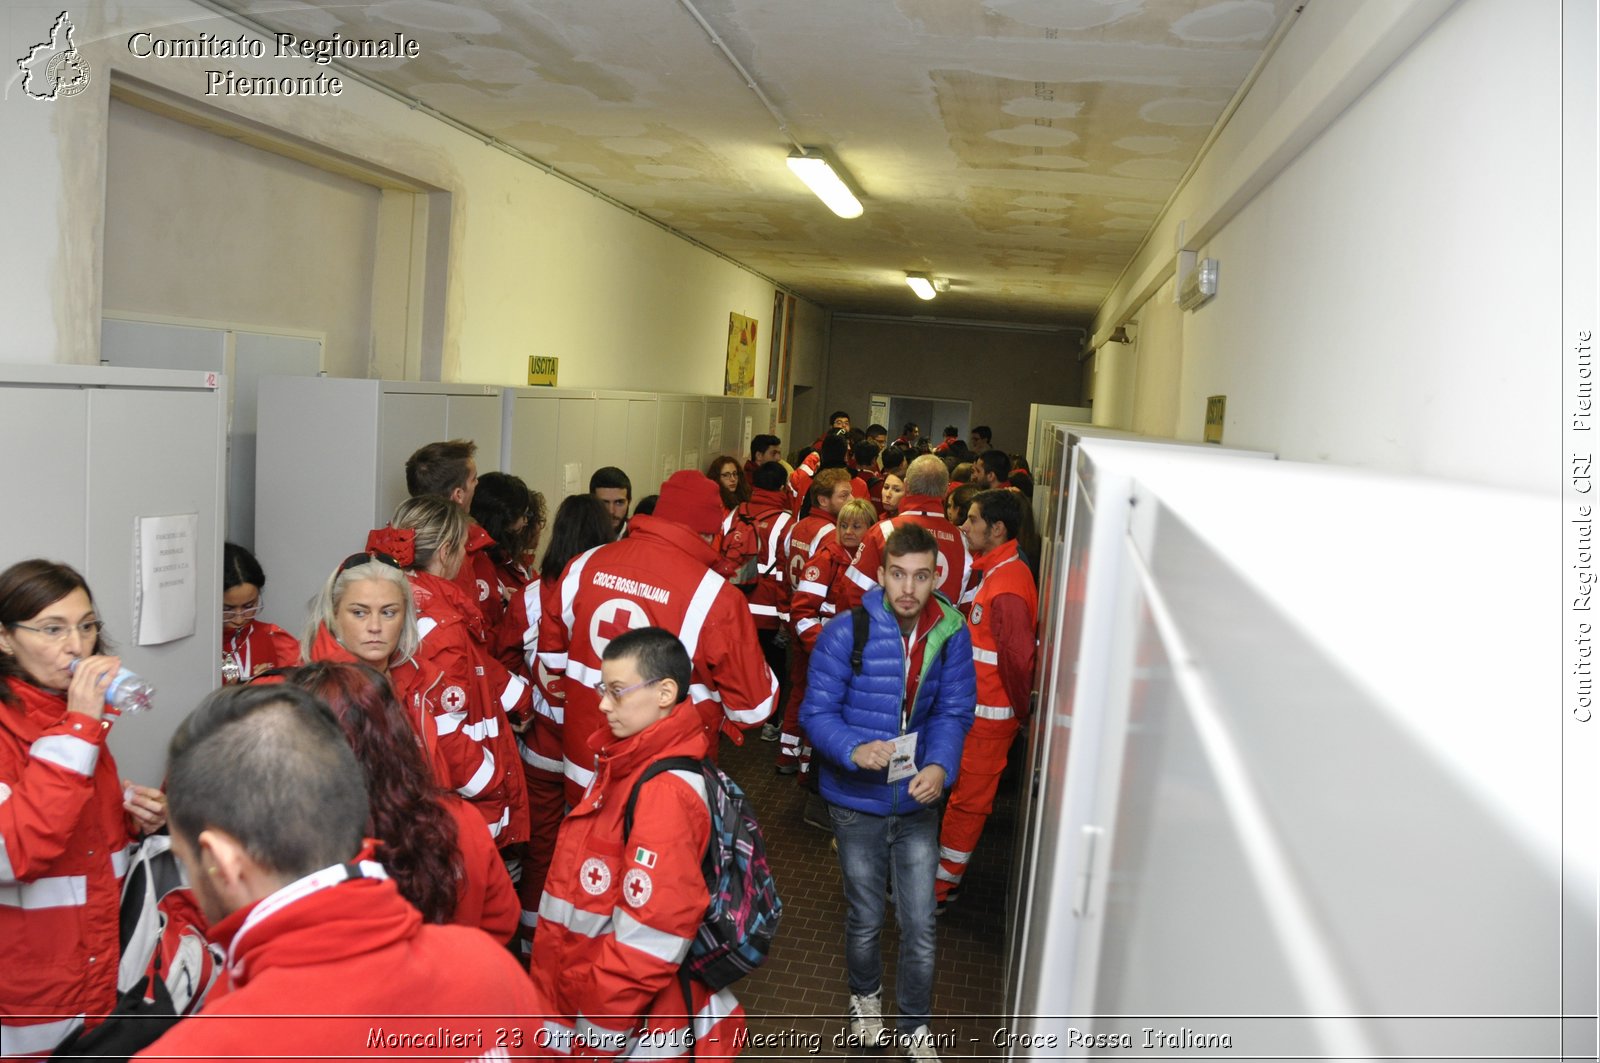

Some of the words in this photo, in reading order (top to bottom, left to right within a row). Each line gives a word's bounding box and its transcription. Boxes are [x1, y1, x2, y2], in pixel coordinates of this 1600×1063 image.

[530, 357, 556, 375] USCITA
[593, 571, 616, 590] CROCE
[614, 577, 639, 597] ROSSA
[638, 582, 670, 605] ITALIANA
